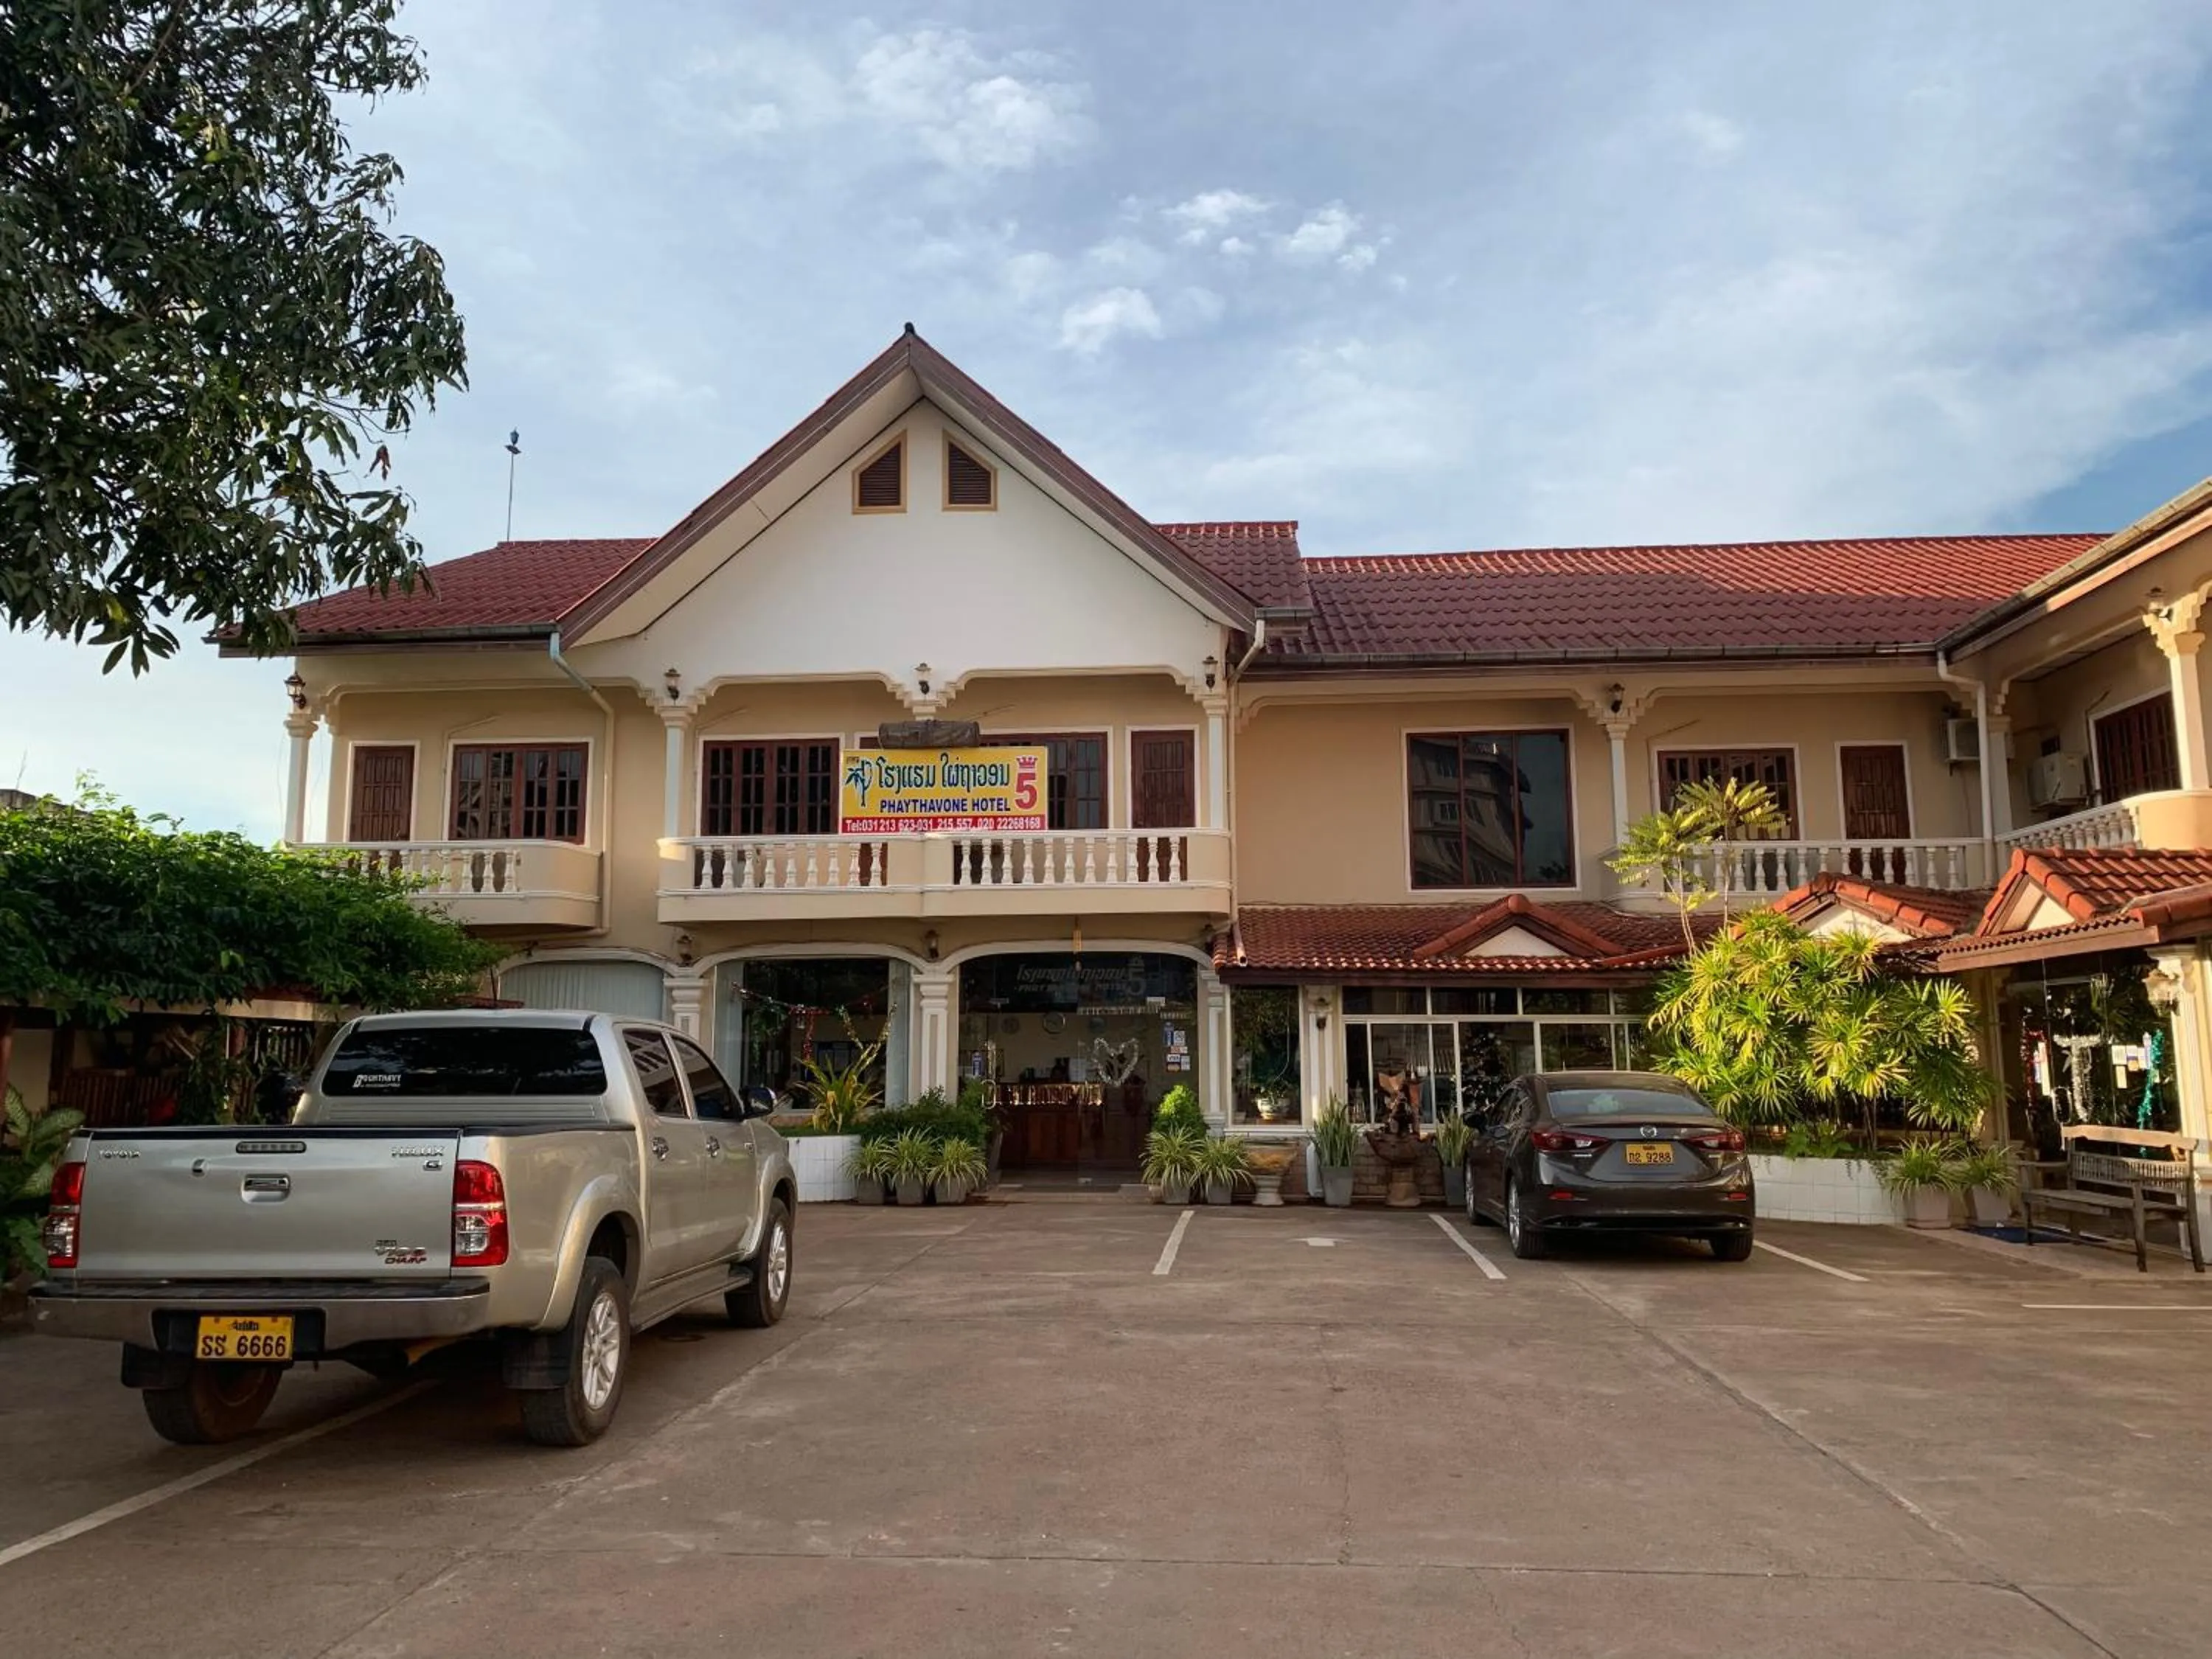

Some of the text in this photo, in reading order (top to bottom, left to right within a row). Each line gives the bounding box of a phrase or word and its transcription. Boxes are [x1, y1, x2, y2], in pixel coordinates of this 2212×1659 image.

[1014, 772, 1037, 810] 5
[880, 798, 1011, 813] PHAYTHAVONE HOTEL
[98, 1149, 141, 1158] TOYOTA
[237, 1335, 286, 1357] 6666
